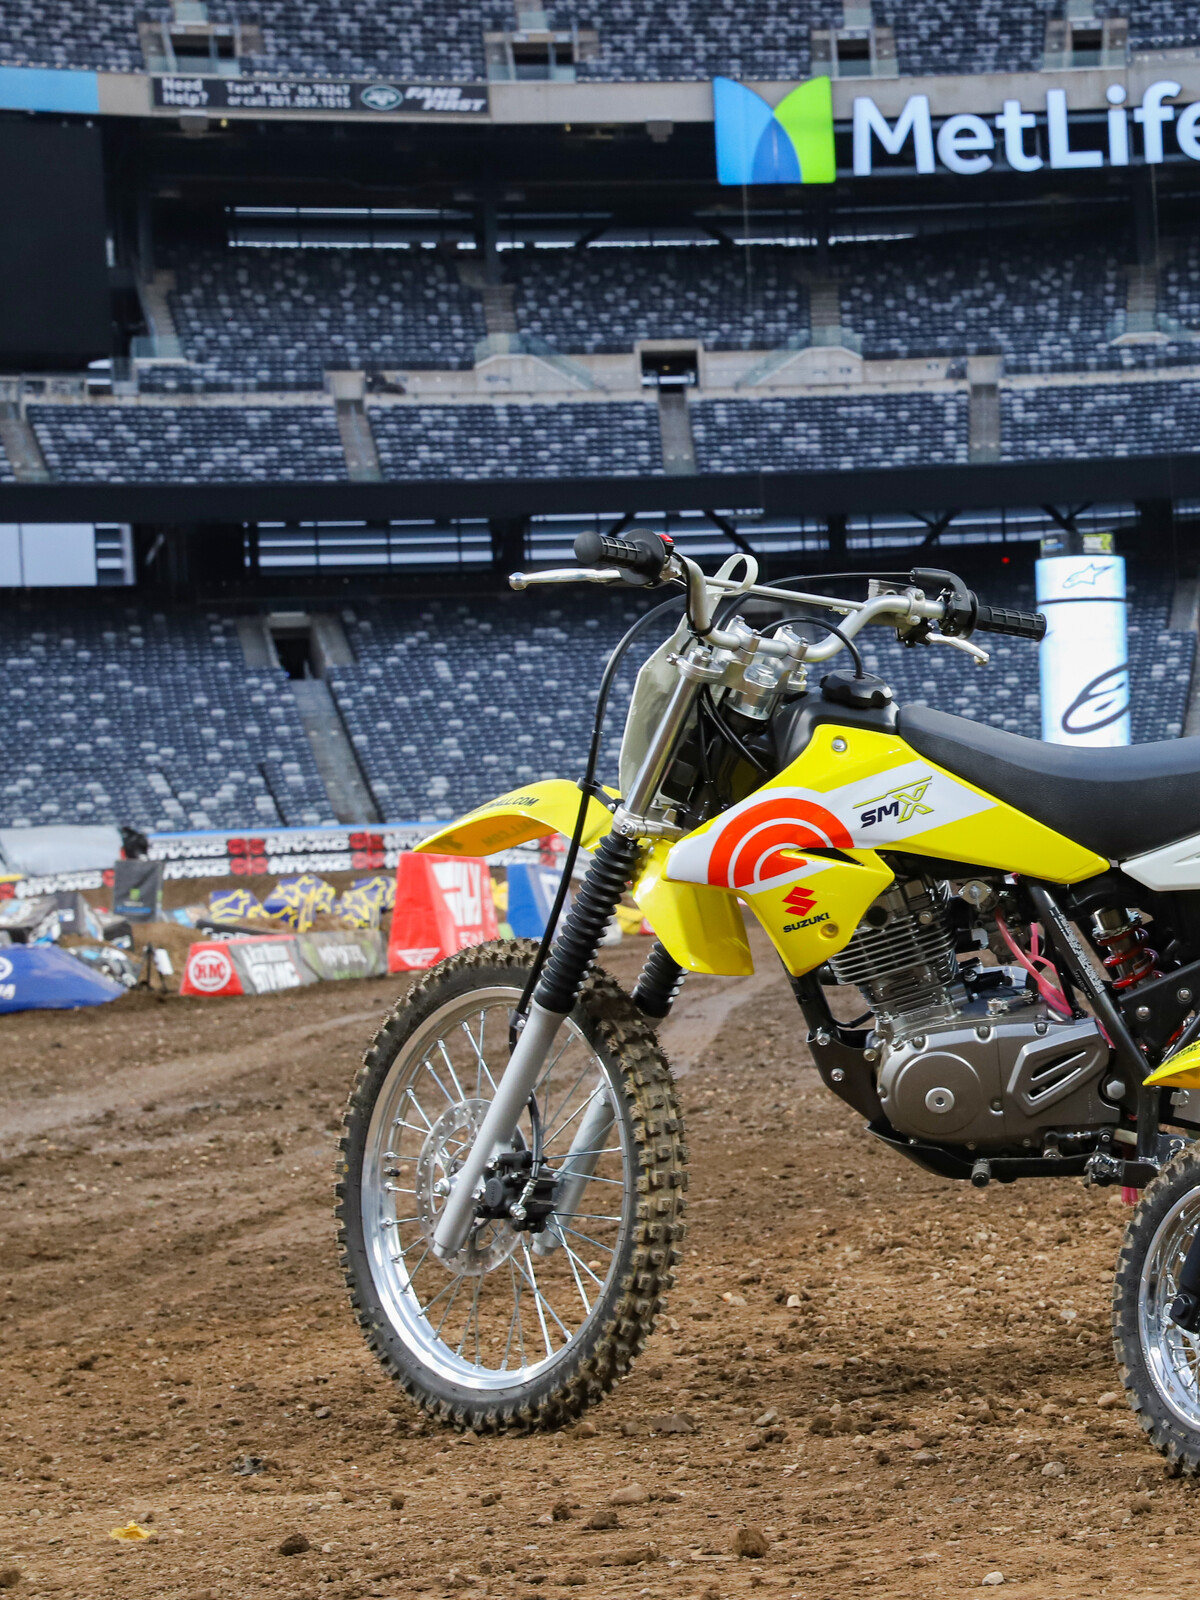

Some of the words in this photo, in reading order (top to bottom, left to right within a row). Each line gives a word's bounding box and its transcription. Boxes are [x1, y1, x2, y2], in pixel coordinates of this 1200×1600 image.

[162, 78, 203, 92] Need
[163, 91, 209, 107] Help?
[405, 86, 462, 100] FANS
[422, 98, 486, 111] FIRST
[860, 782, 935, 829] SMX
[783, 912, 832, 933] SUZUKI
